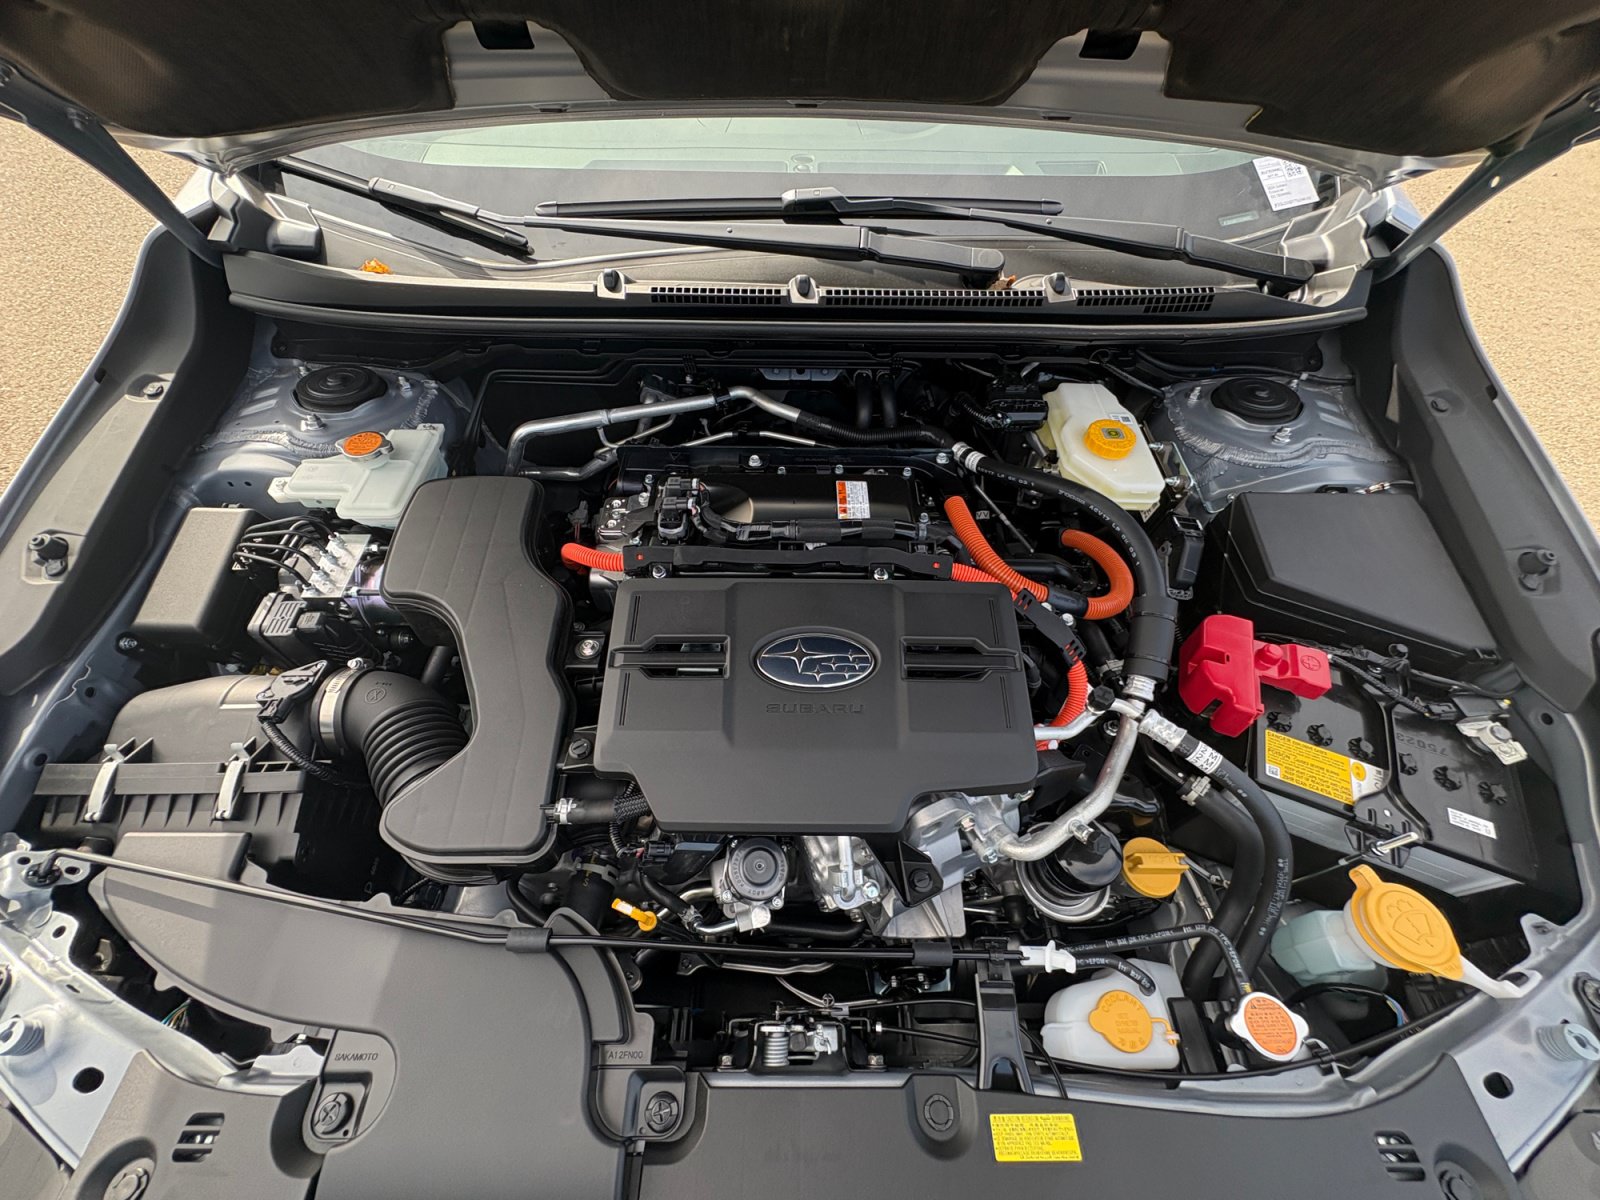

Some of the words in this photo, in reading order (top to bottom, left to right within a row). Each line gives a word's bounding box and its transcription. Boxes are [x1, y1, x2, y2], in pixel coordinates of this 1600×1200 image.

[766, 703, 865, 715] SUBARU
[1209, 752, 1218, 761] M
[1204, 758, 1214, 768] M
[1101, 993, 1144, 1013] COOLANT
[334, 1052, 379, 1062] SAKAMOTO
